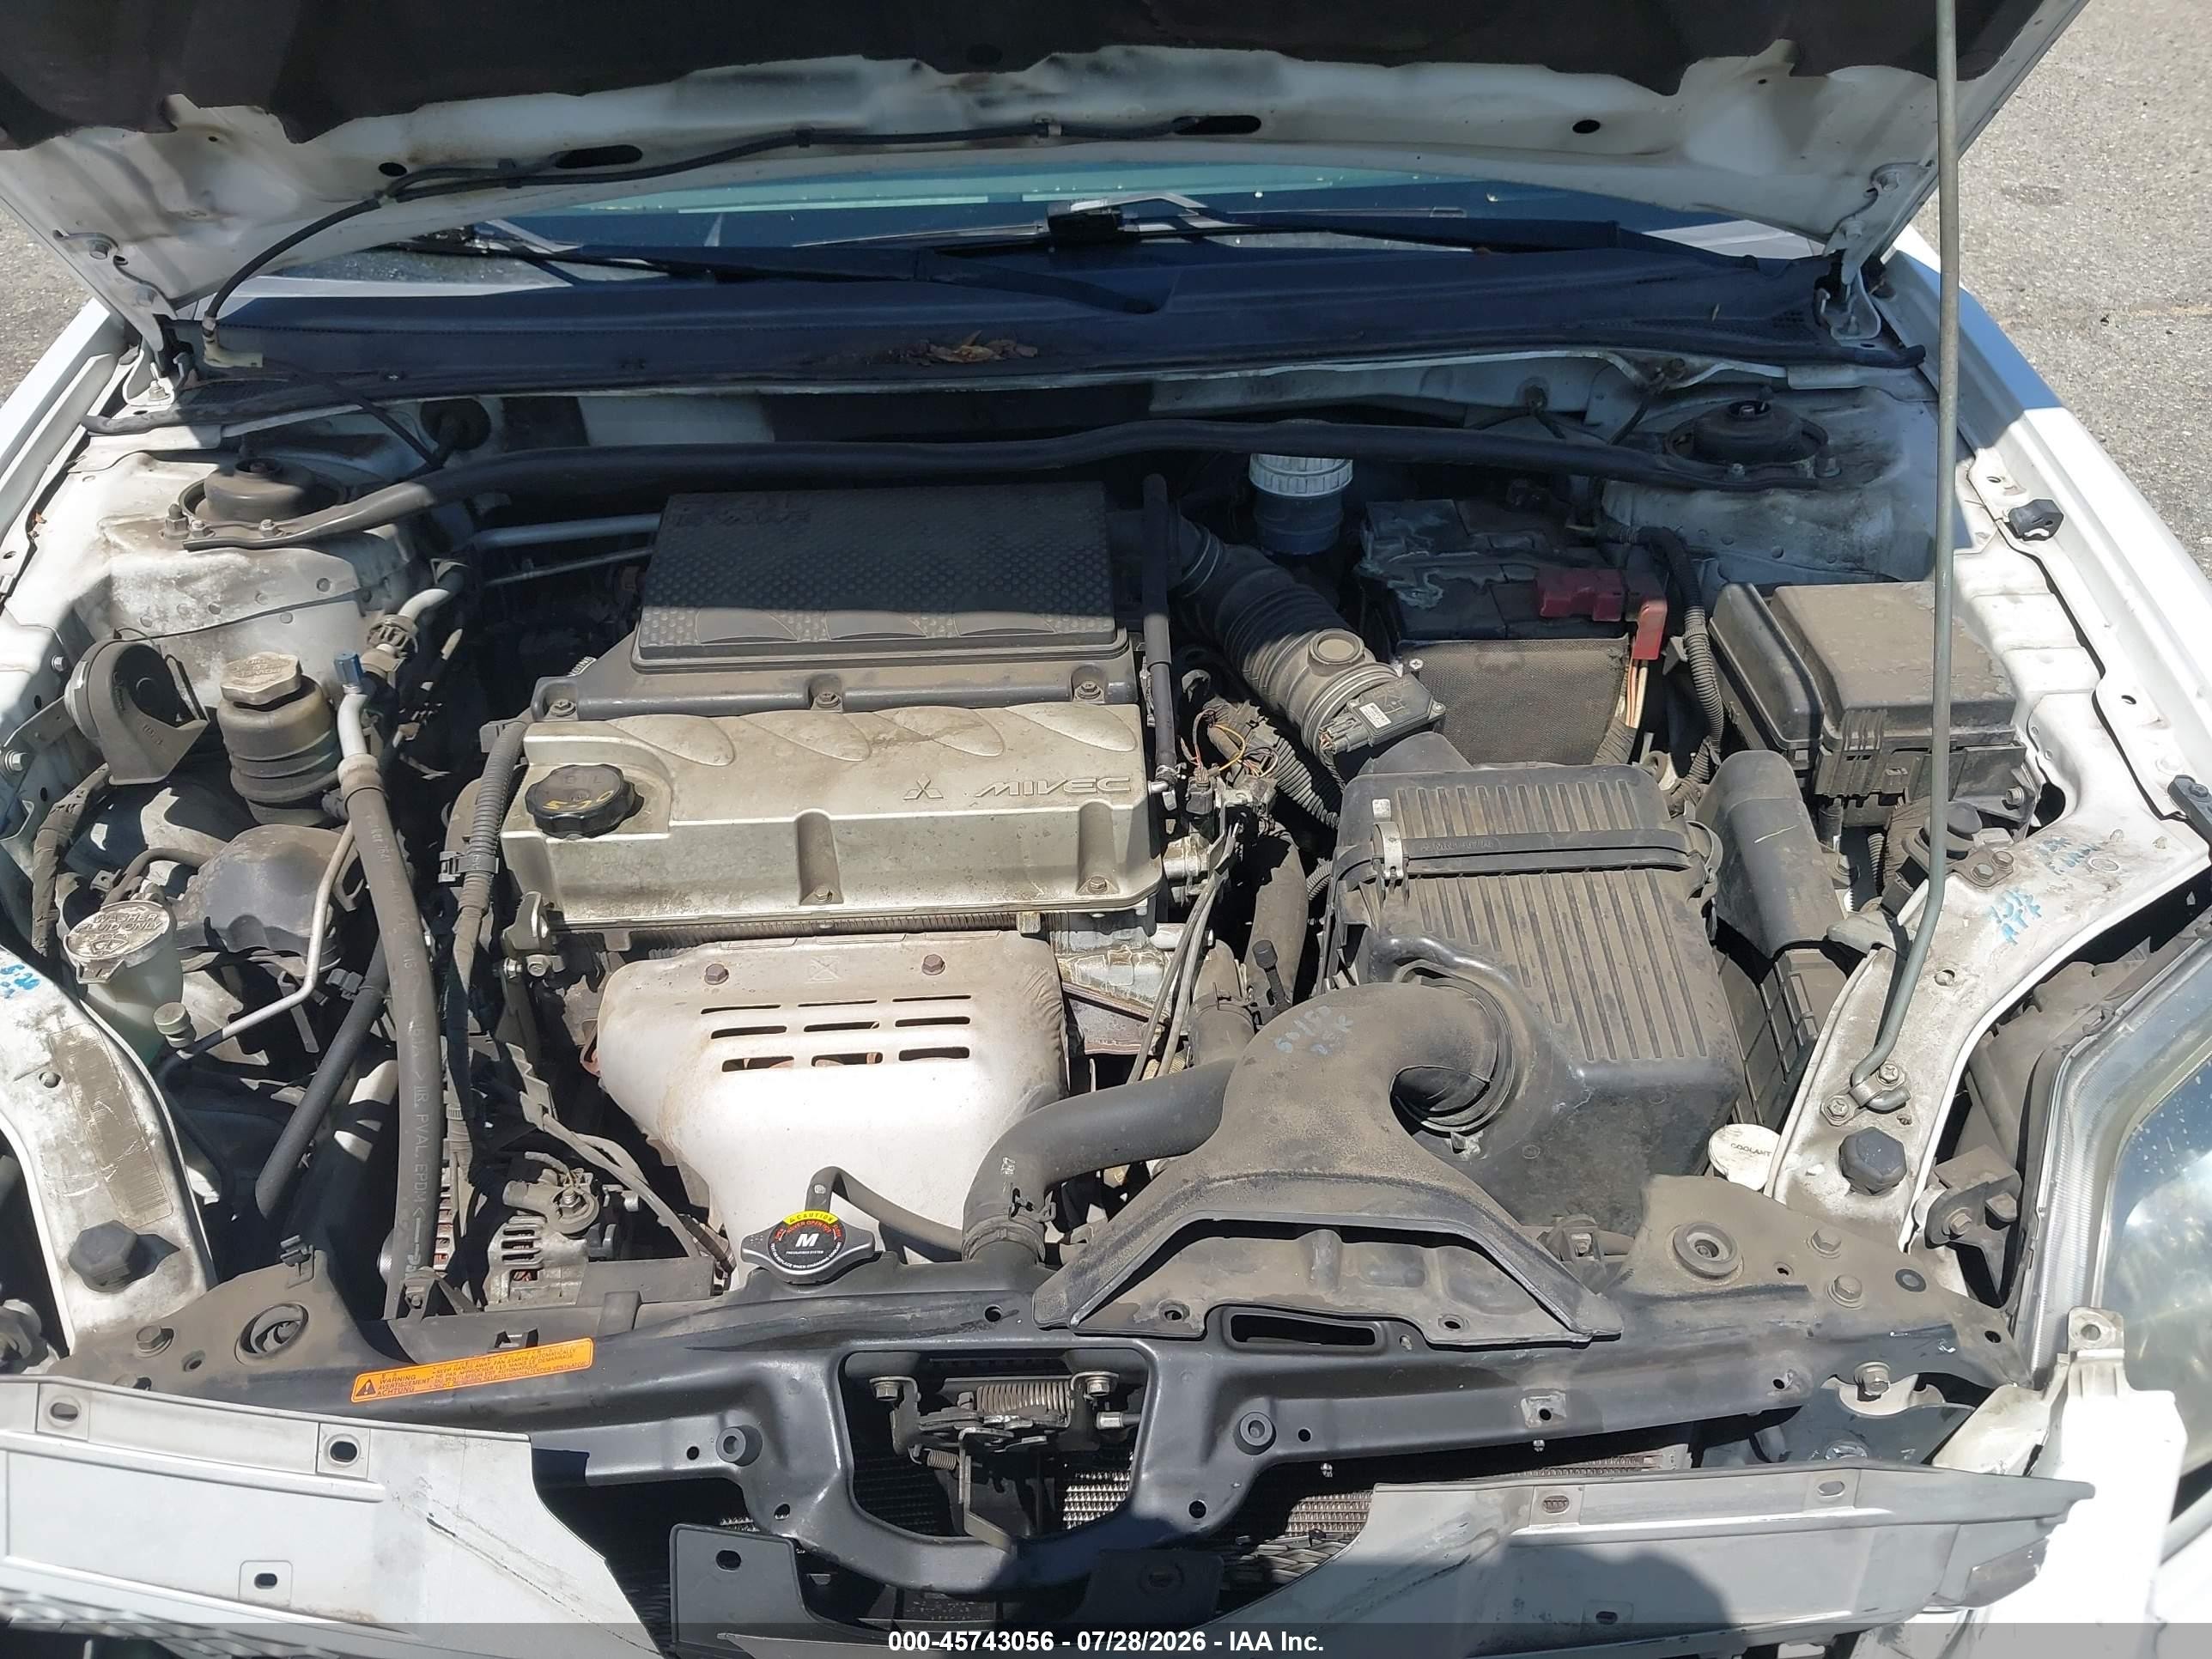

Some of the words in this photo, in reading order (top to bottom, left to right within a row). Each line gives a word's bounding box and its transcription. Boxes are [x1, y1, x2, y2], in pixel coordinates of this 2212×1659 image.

[975, 776, 1131, 798] MIVEC
[94, 913, 158, 924] WASHER
[75, 922, 120, 933] FLUID
[125, 921, 162, 932] ONLY
[1731, 1143, 1772, 1158] COOLANT
[414, 1164, 428, 1202] EPDM
[797, 1212, 834, 1221] CAUTION
[795, 1233, 819, 1247] M
[380, 1374, 416, 1384] WARNING
[377, 1385, 416, 1396] ACHTUNG
